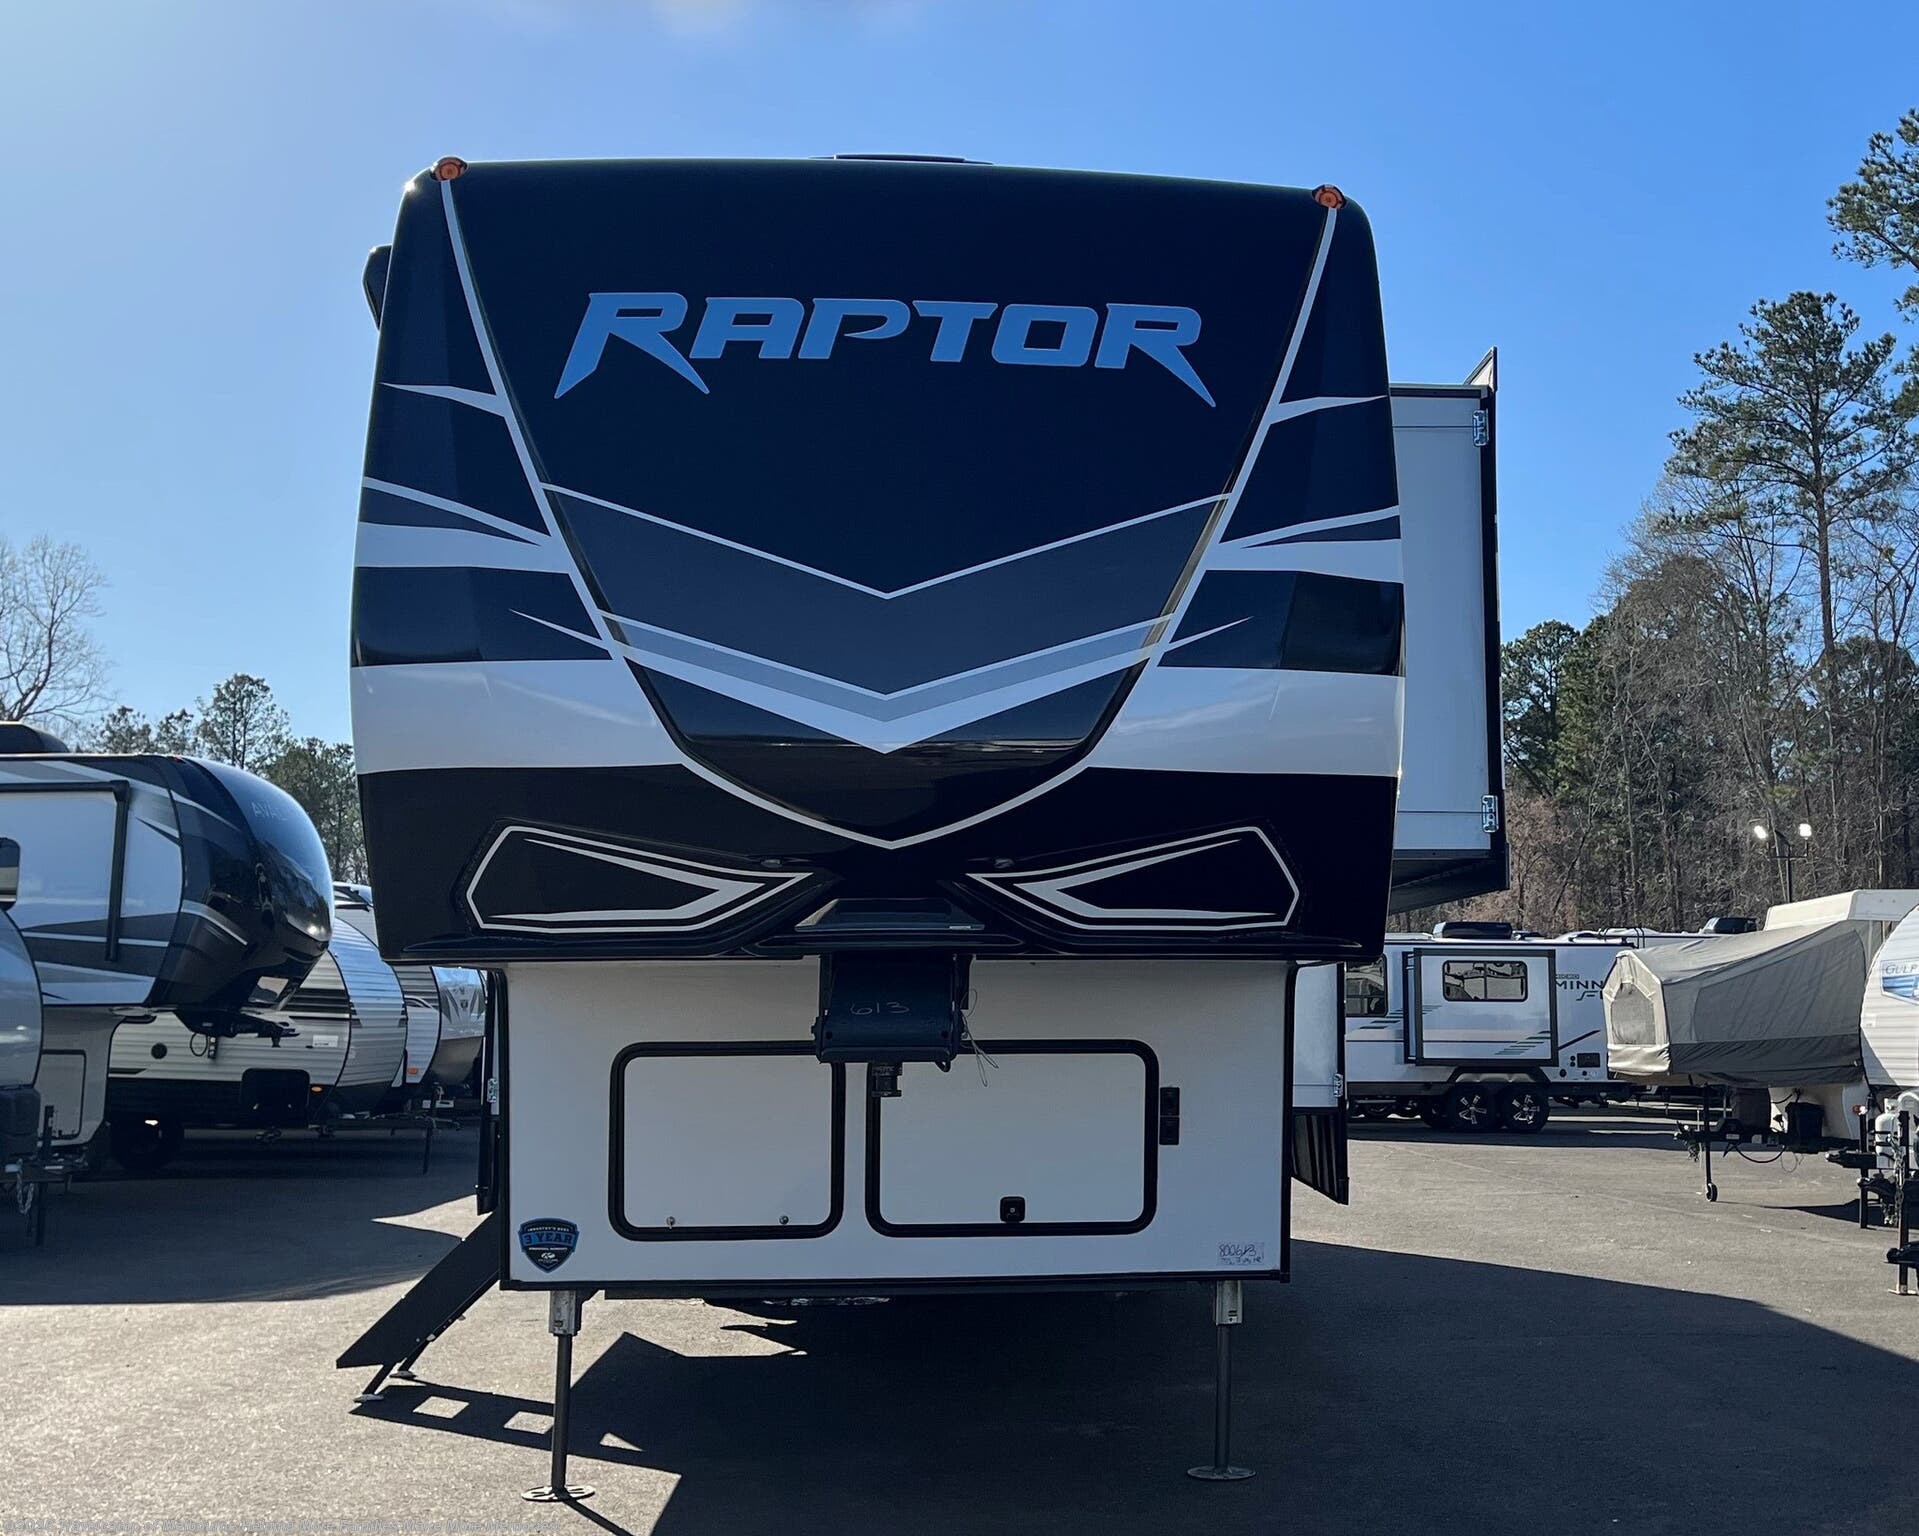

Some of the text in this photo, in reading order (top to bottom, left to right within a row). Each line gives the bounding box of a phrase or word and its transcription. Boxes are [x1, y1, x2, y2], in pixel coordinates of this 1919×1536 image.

[554, 292, 1217, 408] RAPTOR
[850, 1001, 911, 1015] 613
[522, 1231, 574, 1246] 3 YEAR
